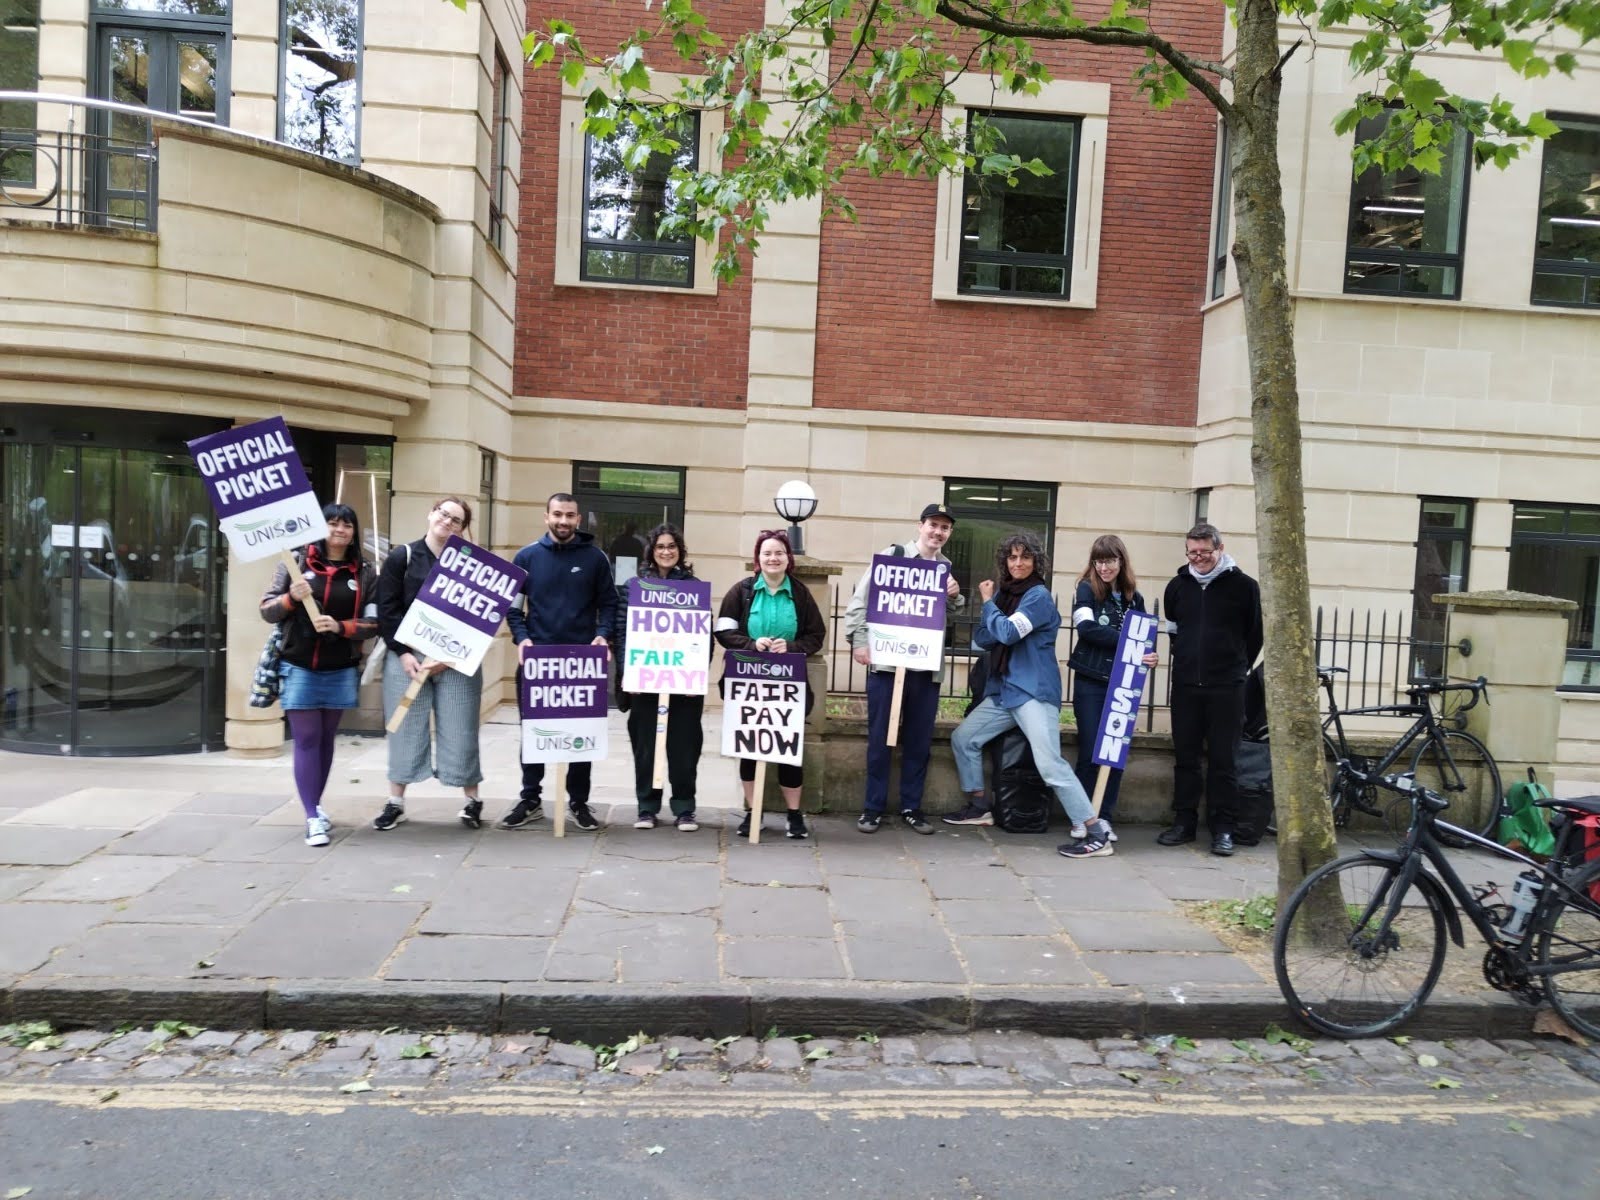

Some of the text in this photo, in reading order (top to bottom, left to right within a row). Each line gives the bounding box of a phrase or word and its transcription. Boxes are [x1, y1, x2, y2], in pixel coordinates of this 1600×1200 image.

[196, 430, 295, 477] OFFICIAL
[215, 461, 292, 505] PICKET
[244, 514, 311, 546] UNISN
[439, 546, 518, 601] OFFICIAL
[874, 563, 944, 593] OFFICIAL
[429, 573, 499, 620] PICKET
[641, 590, 699, 606] UNISON
[877, 590, 937, 618] PICKET
[632, 610, 710, 635] HONK
[629, 649, 685, 666] FAIR
[875, 640, 929, 657] UNISN
[524, 658, 608, 680] OFFICIAL
[638, 668, 706, 692] PAY!
[736, 662, 793, 677] UNISN
[530, 685, 597, 708] PICKET
[731, 681, 799, 702] FAIR
[1098, 614, 1151, 763] UNISON
[741, 706, 793, 727] PAY
[536, 736, 596, 751] UNISN
[735, 729, 800, 757] NOW
